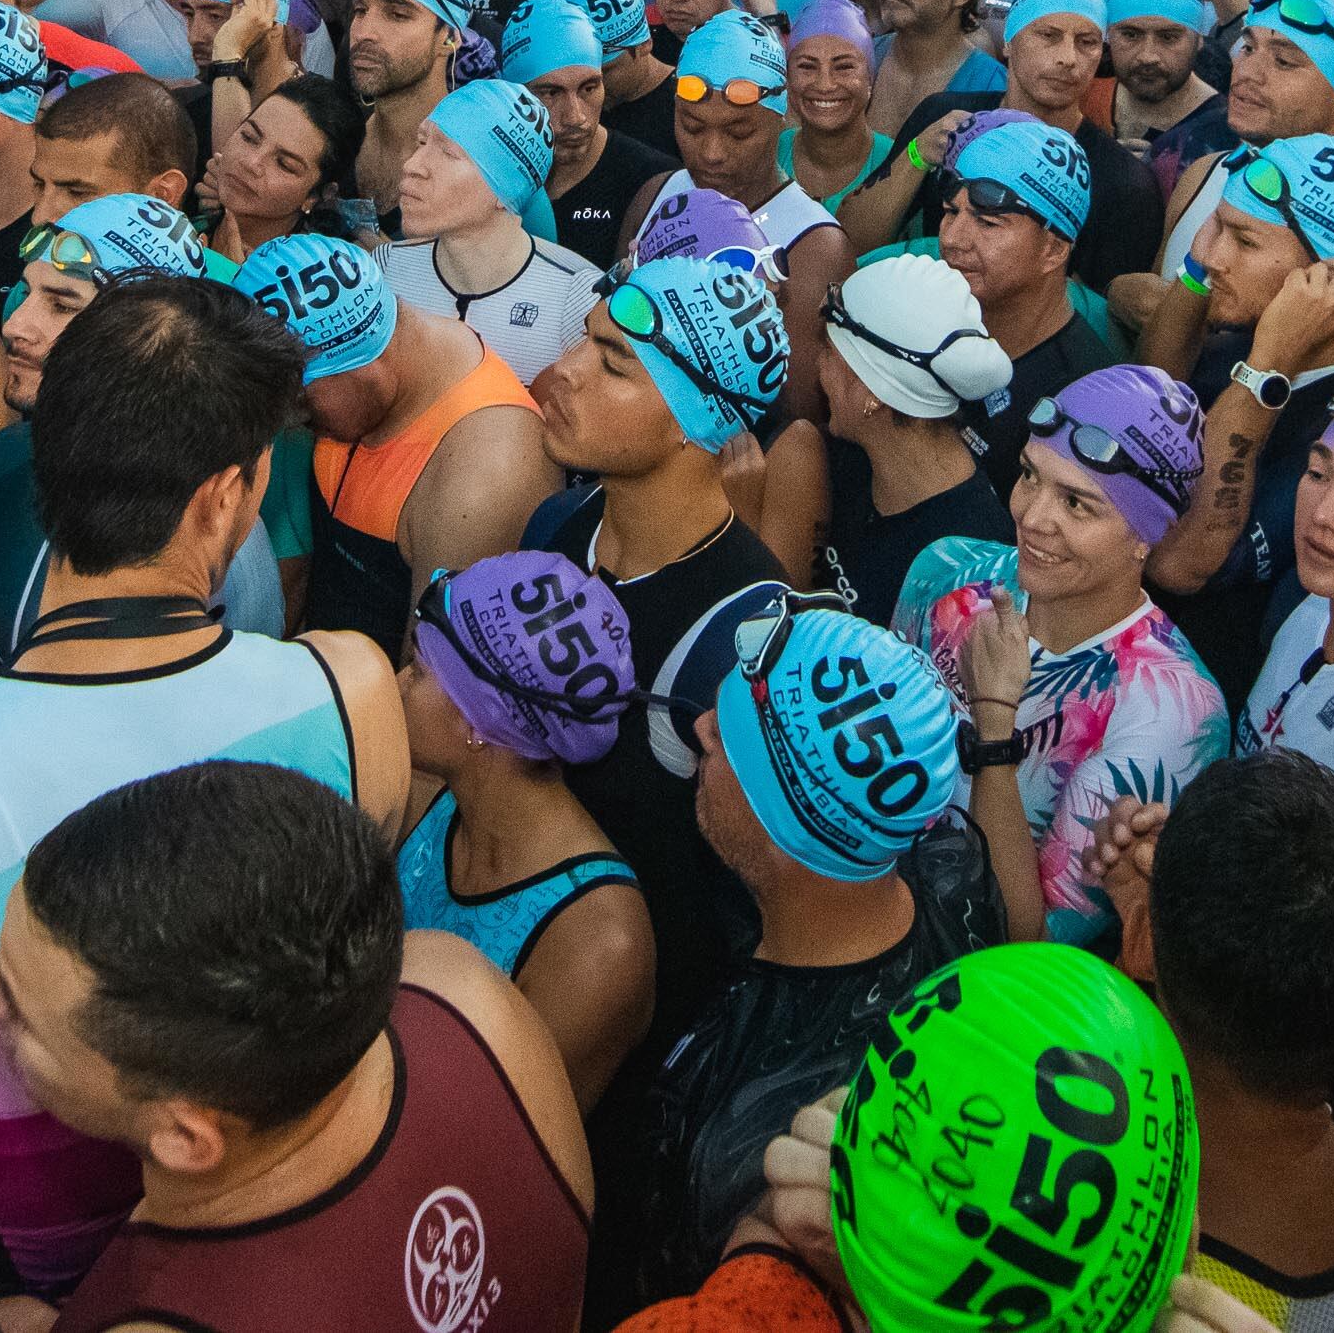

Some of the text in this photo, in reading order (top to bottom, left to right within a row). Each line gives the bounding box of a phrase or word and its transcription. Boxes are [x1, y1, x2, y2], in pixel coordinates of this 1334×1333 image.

[667, 291, 708, 367] CARTAGENA
[510, 572, 620, 716] 5i50
[764, 702, 793, 780] TAGENA
[811, 655, 930, 818] 5i50
